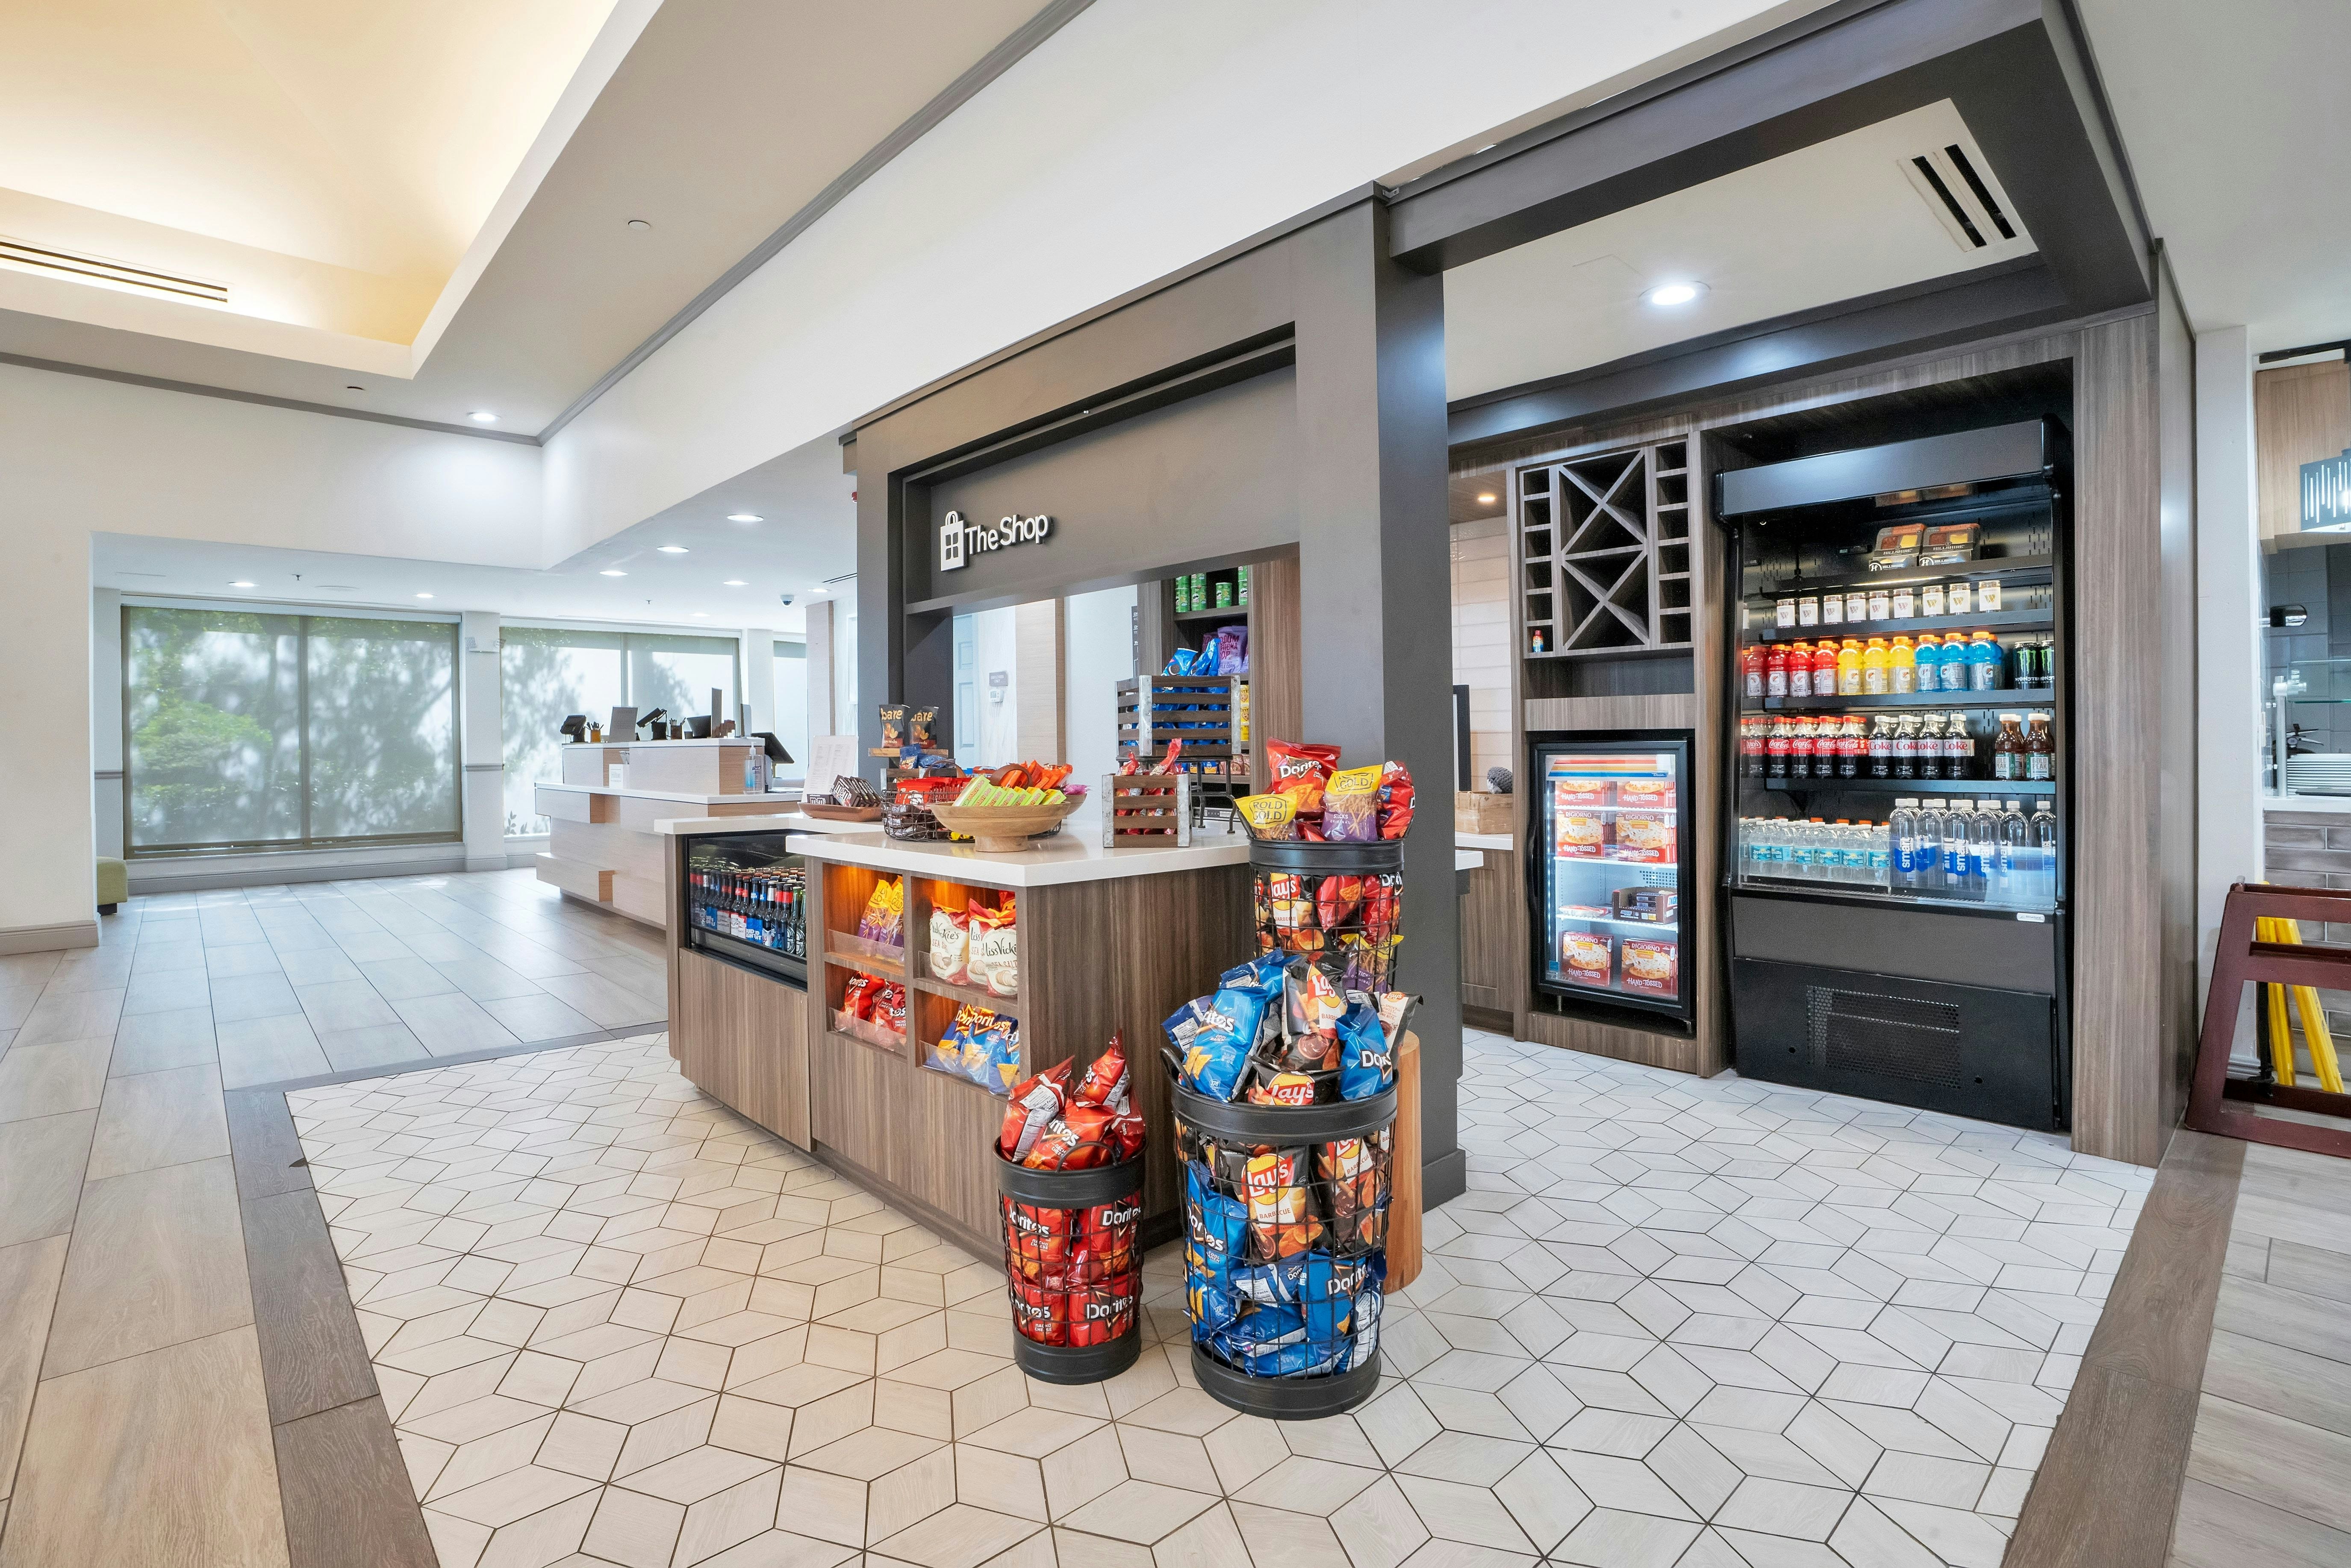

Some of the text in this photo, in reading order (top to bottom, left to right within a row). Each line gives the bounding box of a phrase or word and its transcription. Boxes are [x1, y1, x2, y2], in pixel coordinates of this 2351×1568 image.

[964, 514, 1048, 555] The Shop
[1220, 642, 1237, 651] HICKA
[881, 708, 902, 720] bare
[1870, 740, 1891, 750] Coke
[1896, 741, 1916, 750] Cok
[1944, 741, 1968, 750] Coke
[1340, 777, 1369, 789] GOLD
[1561, 793, 1594, 801] HAND-TOSSED
[1623, 794, 1658, 802] HAND-TOSSED
[1253, 801, 1283, 810] ROLD
[1254, 810, 1282, 820] GOLD
[1563, 844, 1596, 853] HAND-TOSSED
[1624, 849, 1659, 857] HAND-TOSSED
[1900, 837, 1910, 868] smart
[971, 927, 981, 940] iss
[1572, 935, 1598, 944] DIGIORNO
[994, 938, 1016, 956] Vicki
[1632, 943, 1660, 952] DIGIORNO
[1567, 968, 1600, 978] HAND-TOSSED
[1626, 977, 1662, 988] HAND-TOSSED
[1271, 1081, 1314, 1106] Lay's
[1247, 1162, 1289, 1197] Lay's
[1259, 1208, 1291, 1219] BARBCUE
